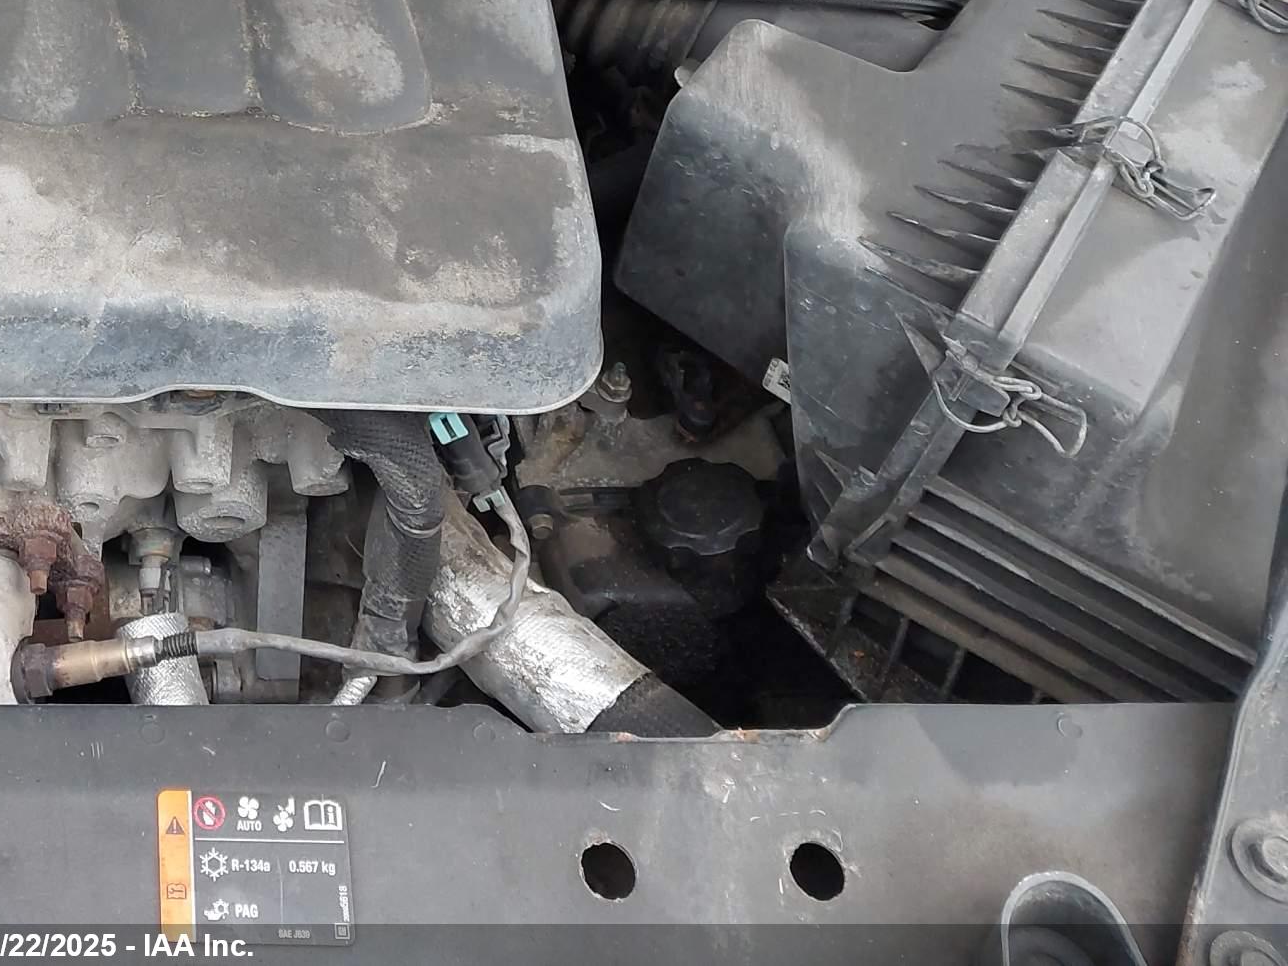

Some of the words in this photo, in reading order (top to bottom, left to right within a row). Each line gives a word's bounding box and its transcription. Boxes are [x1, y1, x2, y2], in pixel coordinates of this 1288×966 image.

[237, 820, 262, 832] AUTO
[231, 859, 271, 873] R-134a
[289, 860, 318, 873] 0.567
[321, 861, 336, 876] kg
[235, 904, 259, 919] PAG
[278, 929, 293, 939] SAE
